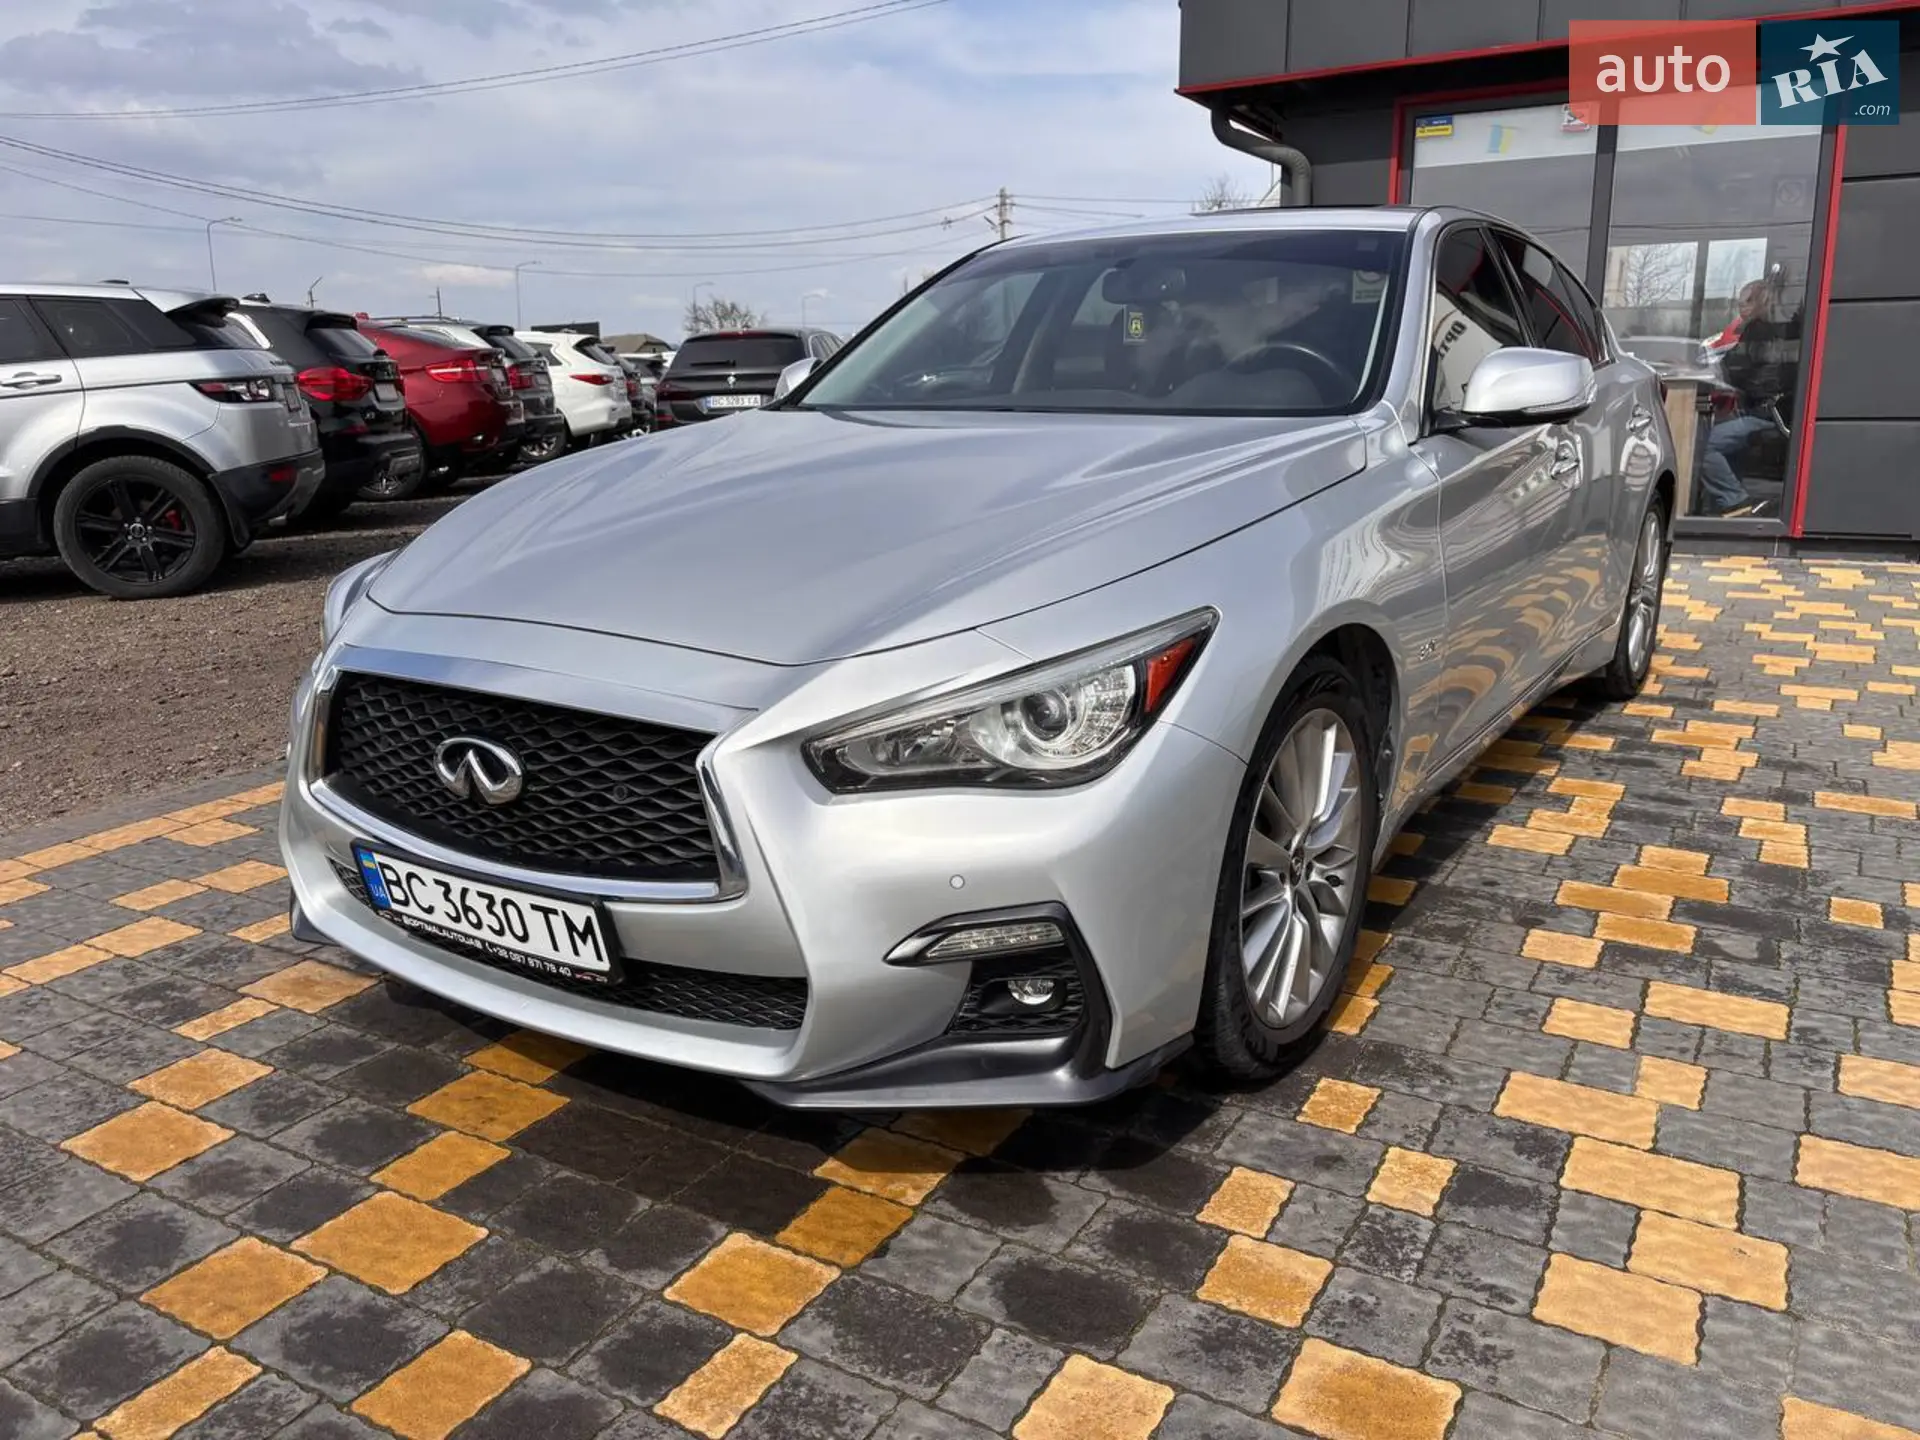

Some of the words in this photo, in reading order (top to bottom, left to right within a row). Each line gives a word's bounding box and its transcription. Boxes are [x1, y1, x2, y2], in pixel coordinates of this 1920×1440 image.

[713, 396, 724, 406] BC
[370, 884, 387, 899] UA
[379, 863, 434, 914] BC
[433, 878, 529, 943] 3630
[529, 903, 604, 962] TM
